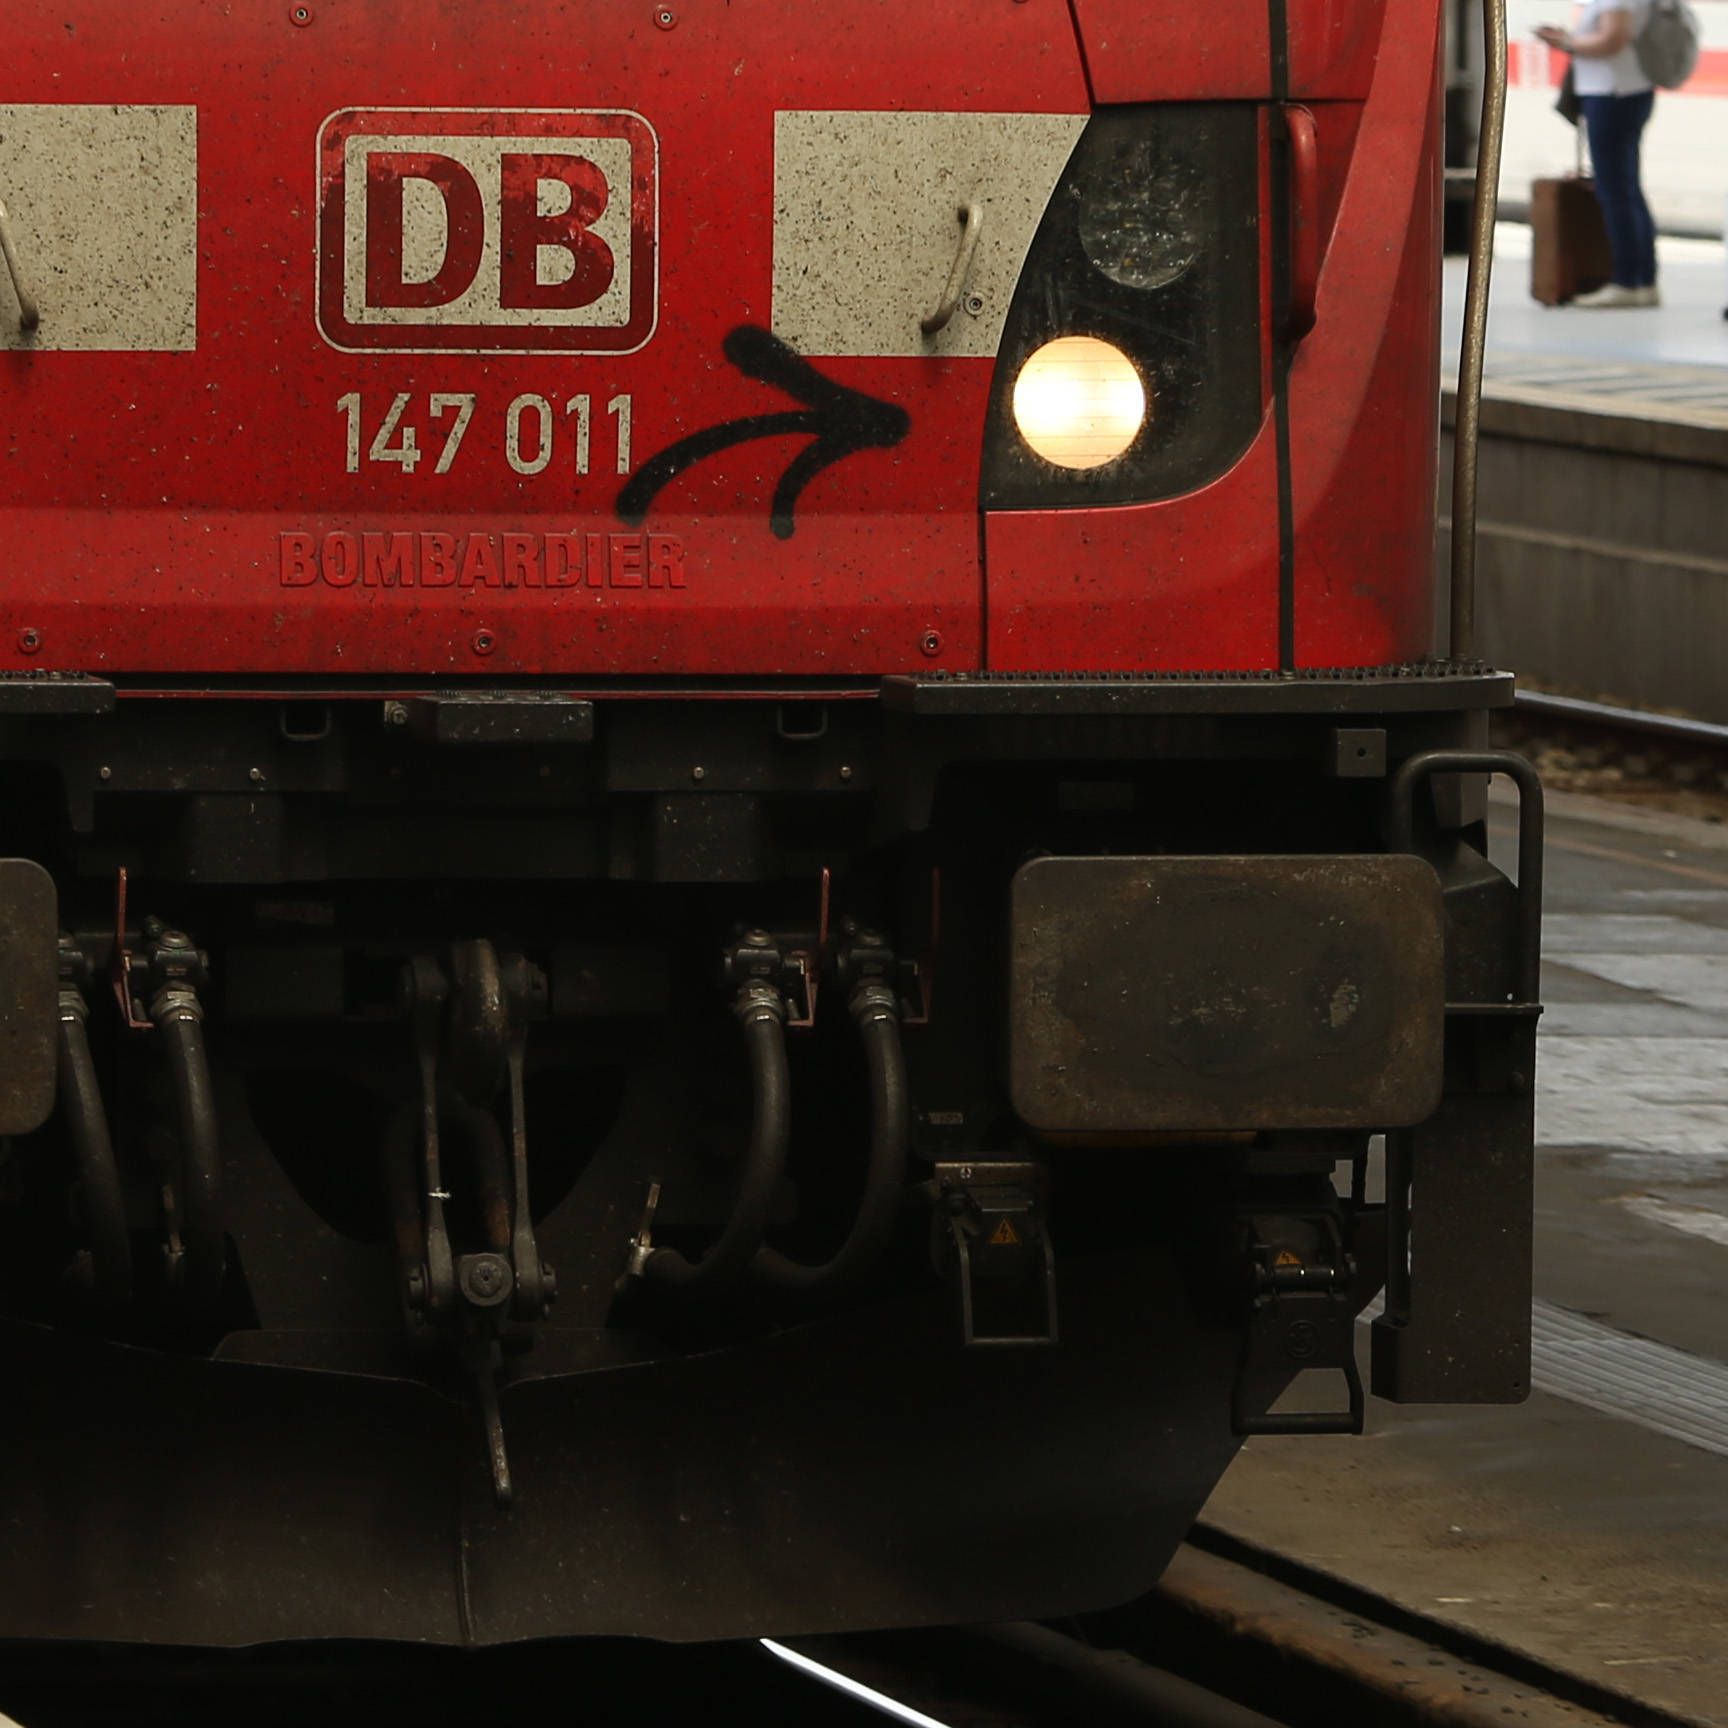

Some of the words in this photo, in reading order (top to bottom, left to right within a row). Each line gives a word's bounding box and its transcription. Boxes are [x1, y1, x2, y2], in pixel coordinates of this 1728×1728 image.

[365, 151, 615, 310] DB
[336, 392, 476, 473] 147
[504, 393, 633, 475] 011
[278, 530, 688, 588] BOMBARDIER
